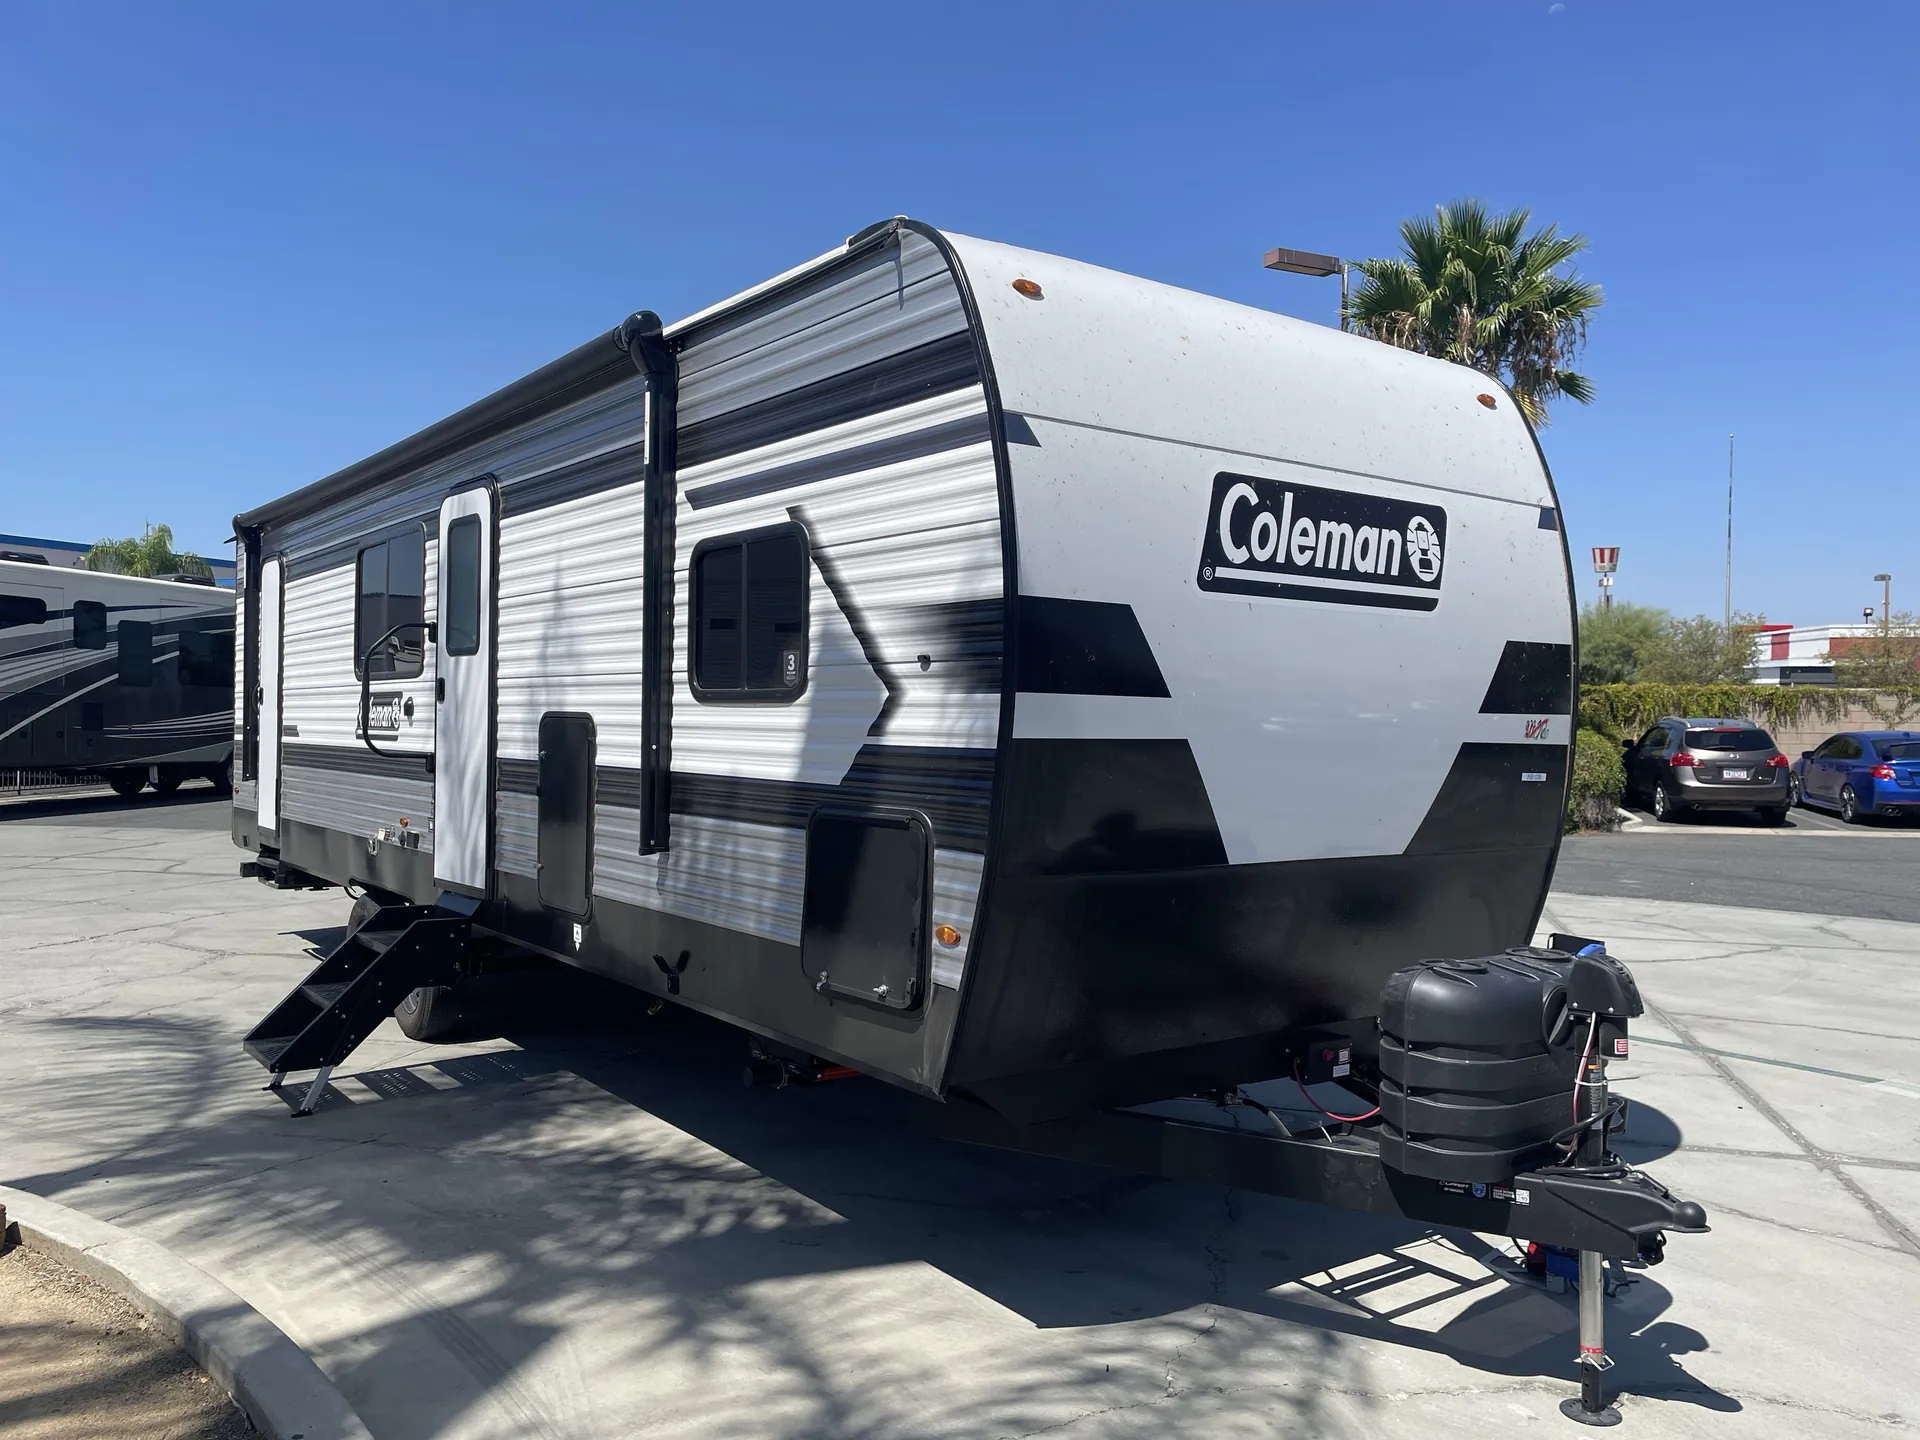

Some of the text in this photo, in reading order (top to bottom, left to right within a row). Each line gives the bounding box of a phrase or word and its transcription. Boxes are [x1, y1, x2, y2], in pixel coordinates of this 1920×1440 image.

[1219, 482, 1402, 576] Coleman
[787, 654, 795, 671] 3
[360, 696, 392, 727] leman
